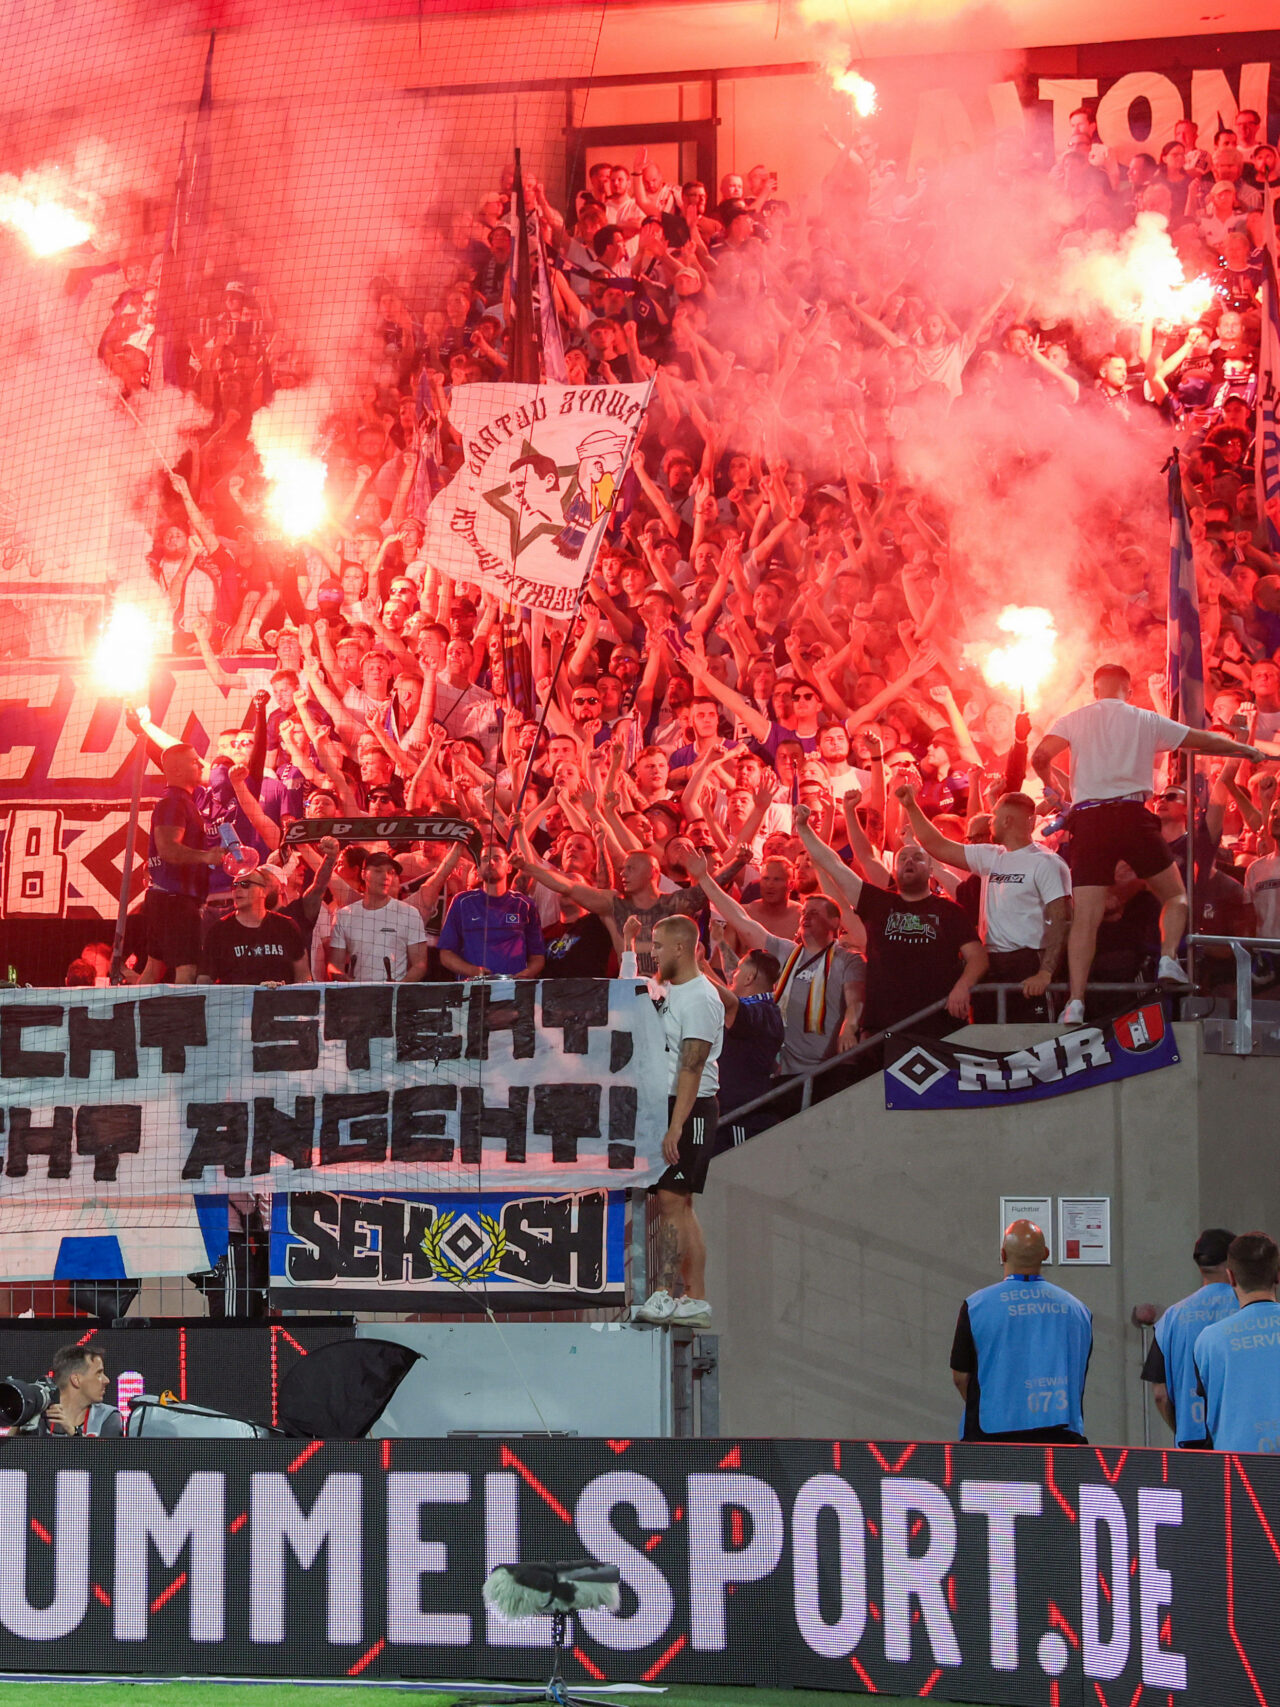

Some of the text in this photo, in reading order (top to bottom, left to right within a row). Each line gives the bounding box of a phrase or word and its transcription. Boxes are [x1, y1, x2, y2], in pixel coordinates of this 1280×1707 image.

[251, 978, 634, 1073] STEHT,
[953, 1027, 1112, 1092] RNR
[182, 1083, 638, 1180] ANGEHT!
